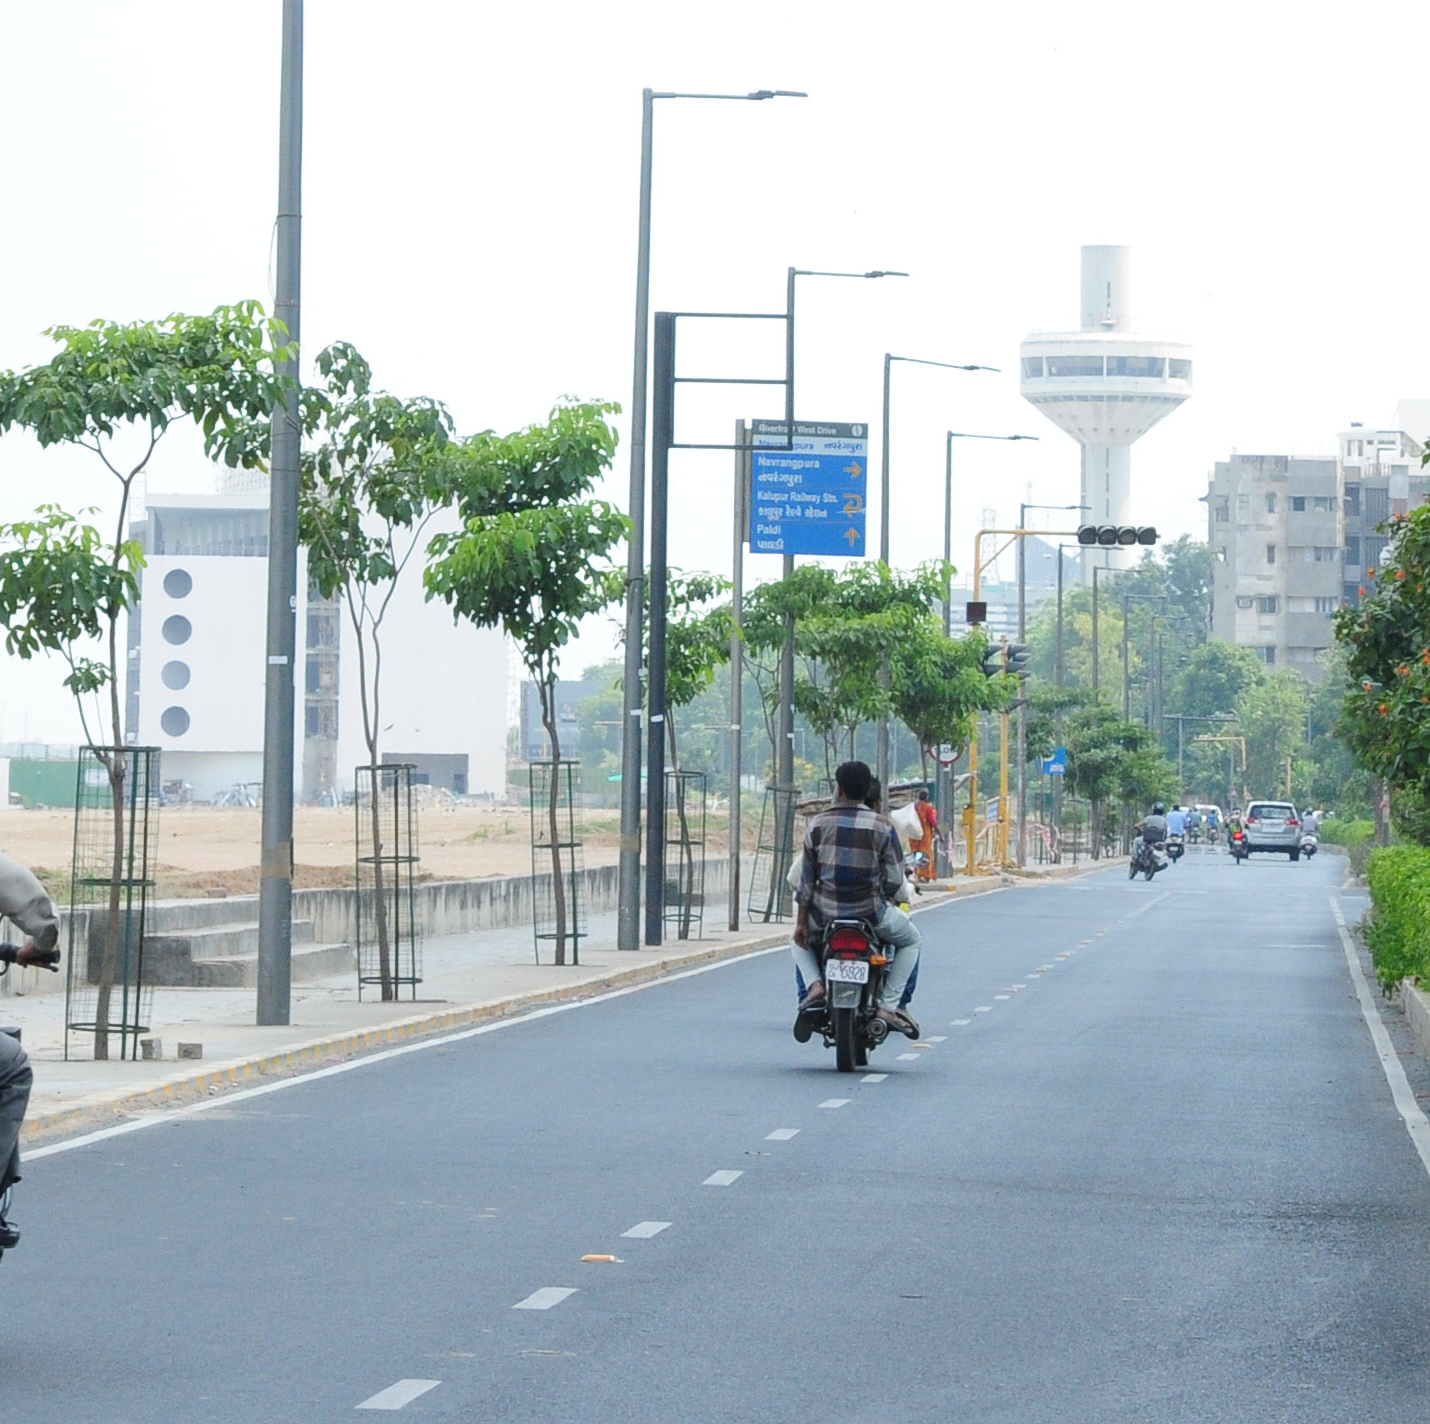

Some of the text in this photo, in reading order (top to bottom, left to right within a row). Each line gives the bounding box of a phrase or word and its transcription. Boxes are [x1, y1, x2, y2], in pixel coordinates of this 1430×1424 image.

[797, 425, 816, 434] West
[816, 426, 837, 435] Drive
[757, 456, 820, 470] Navrangpura
[757, 490, 789, 503] Kalupur
[789, 491, 822, 505] Railway
[757, 524, 782, 536] Paldi
